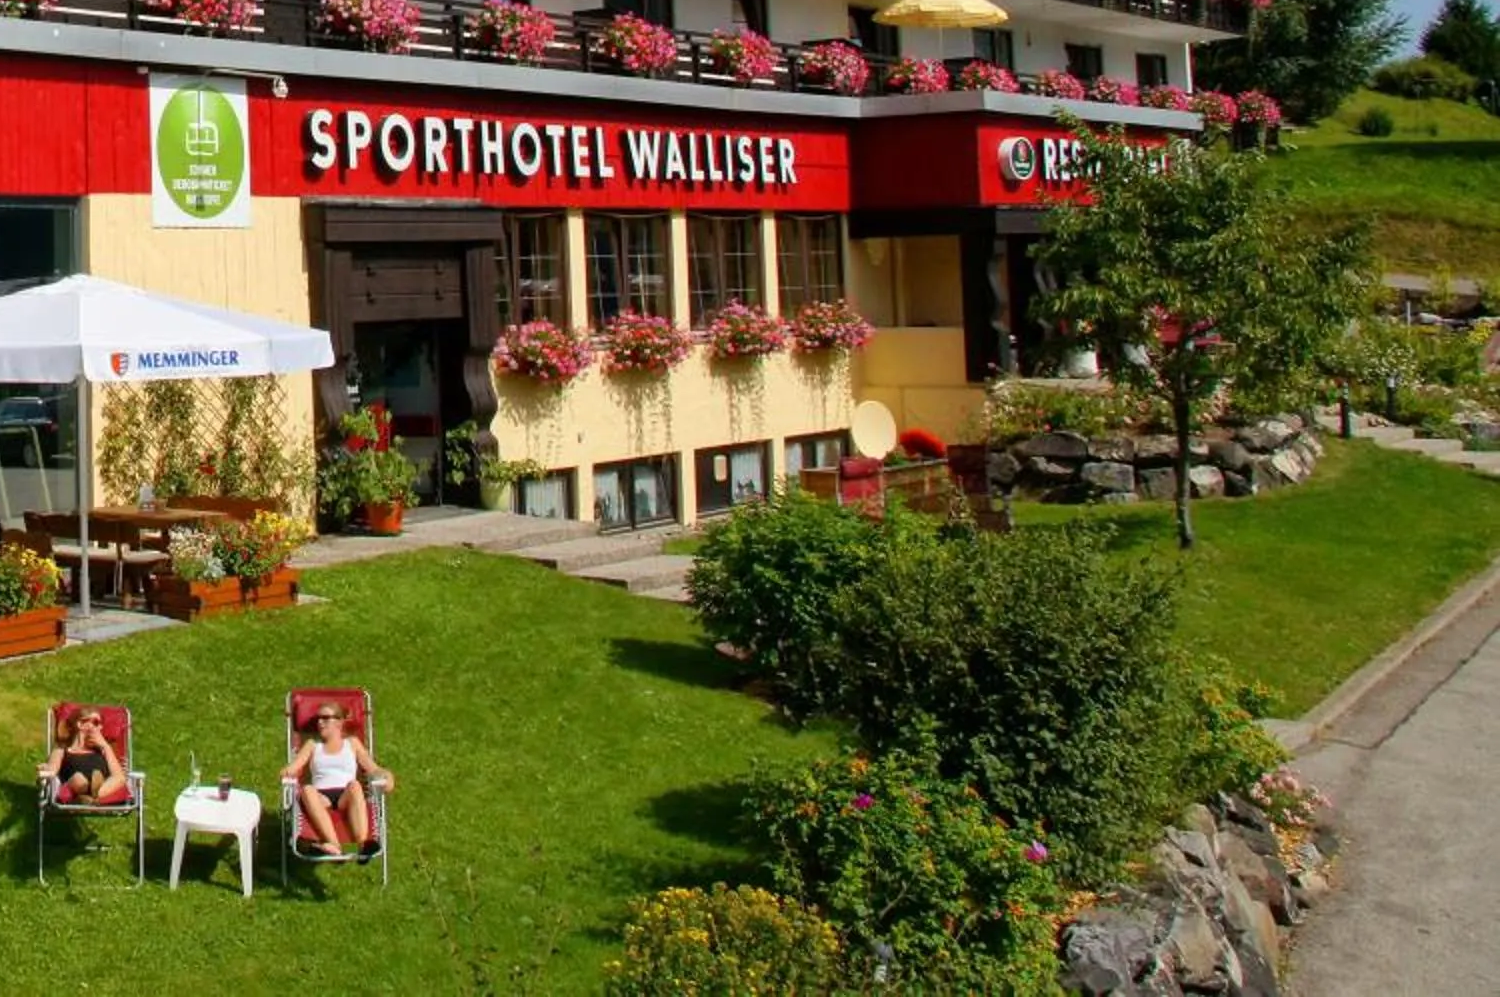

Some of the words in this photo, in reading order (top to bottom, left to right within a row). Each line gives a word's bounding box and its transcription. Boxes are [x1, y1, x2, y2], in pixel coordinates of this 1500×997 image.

[311, 109, 614, 178] SPORTHOTEL
[627, 130, 798, 184] WALLISER
[138, 350, 239, 369] MEMMINGER
